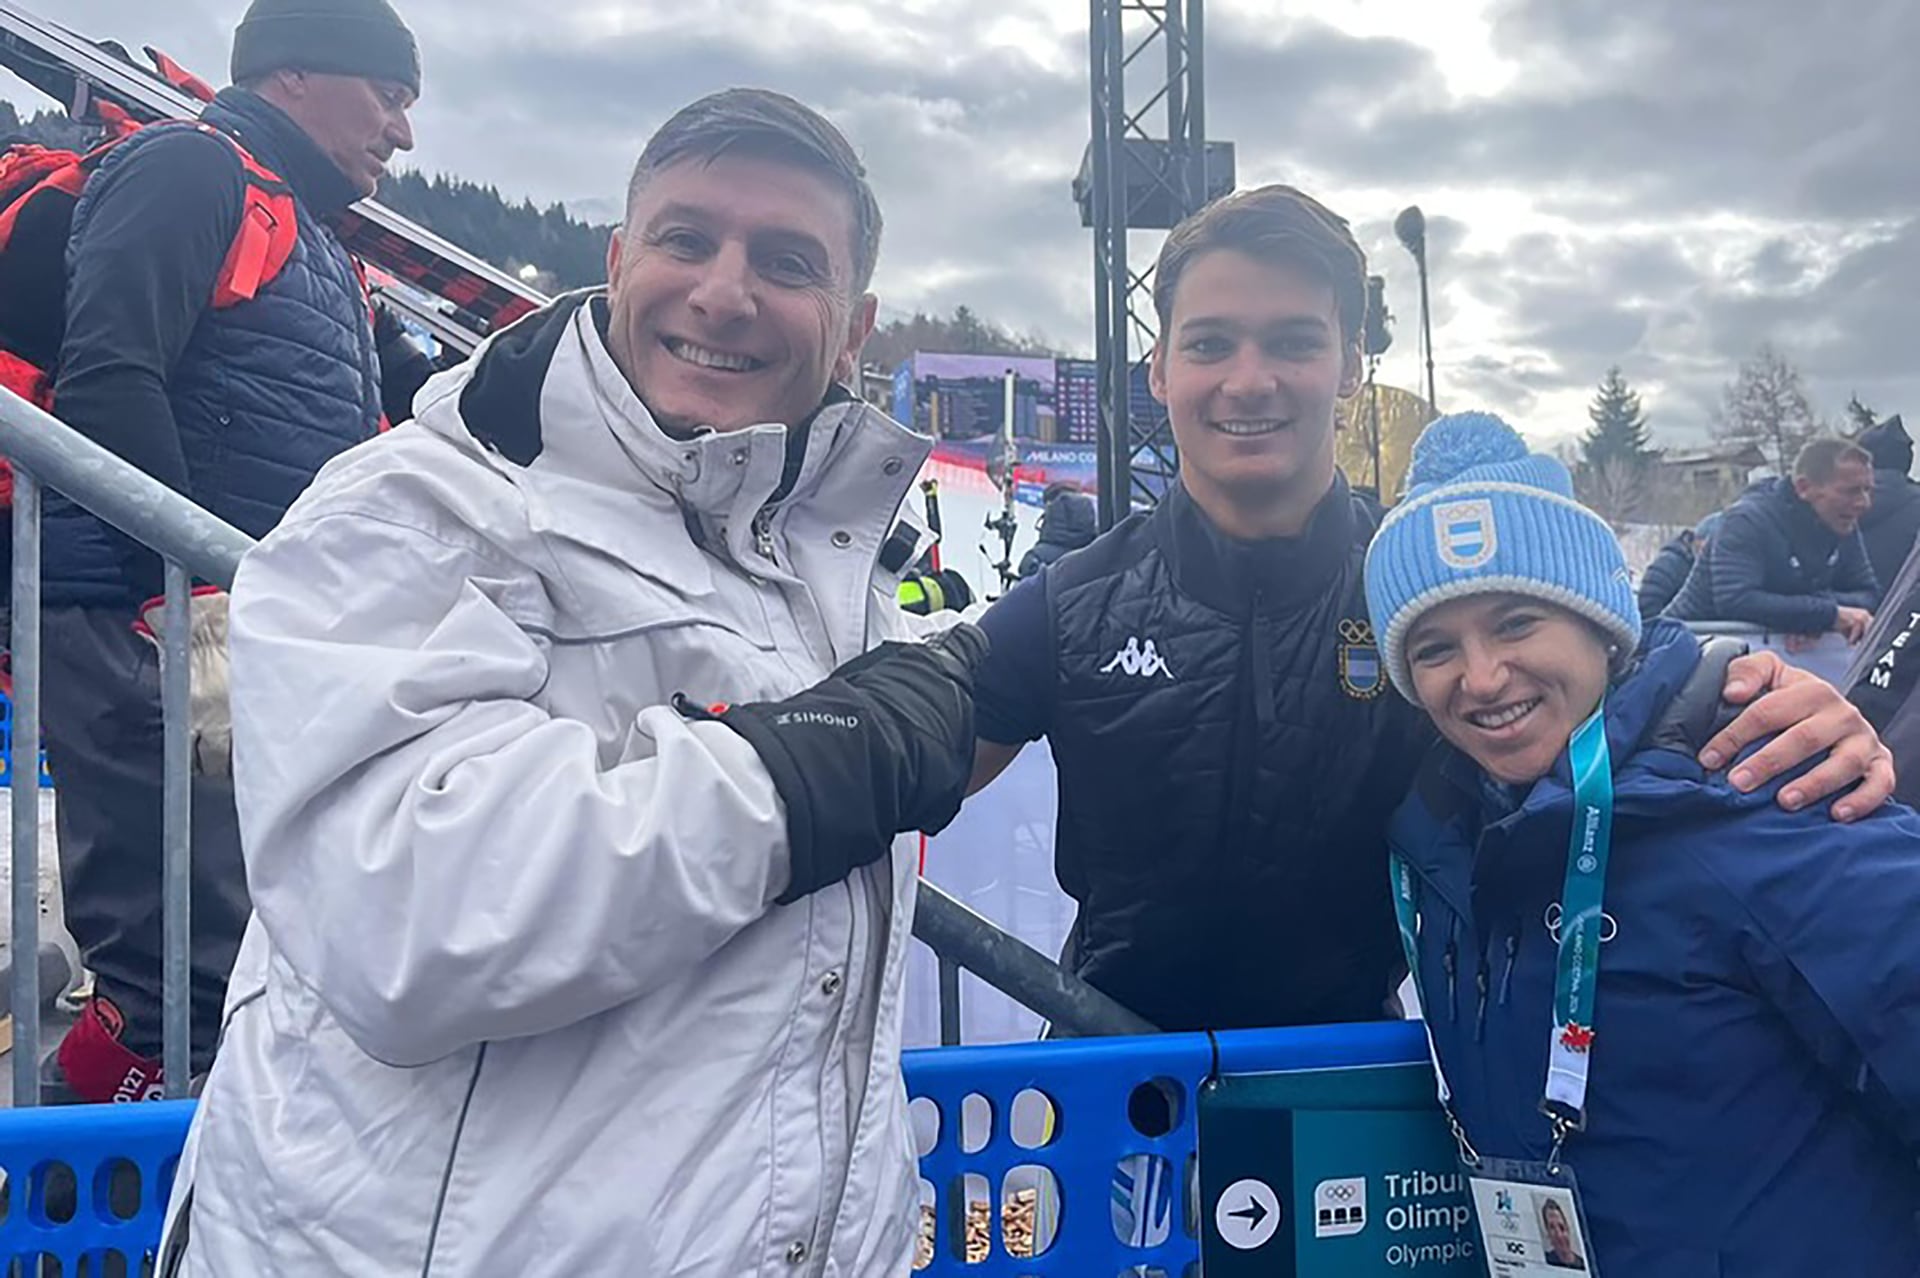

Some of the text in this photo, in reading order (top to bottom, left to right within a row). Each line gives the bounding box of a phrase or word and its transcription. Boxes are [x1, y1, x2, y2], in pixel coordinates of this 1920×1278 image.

[1026, 451, 1097, 464] MILANO CO
[1869, 612, 1920, 688] TEAM
[793, 711, 859, 729] SIMOND
[1385, 1238, 1473, 1269] Olympic
